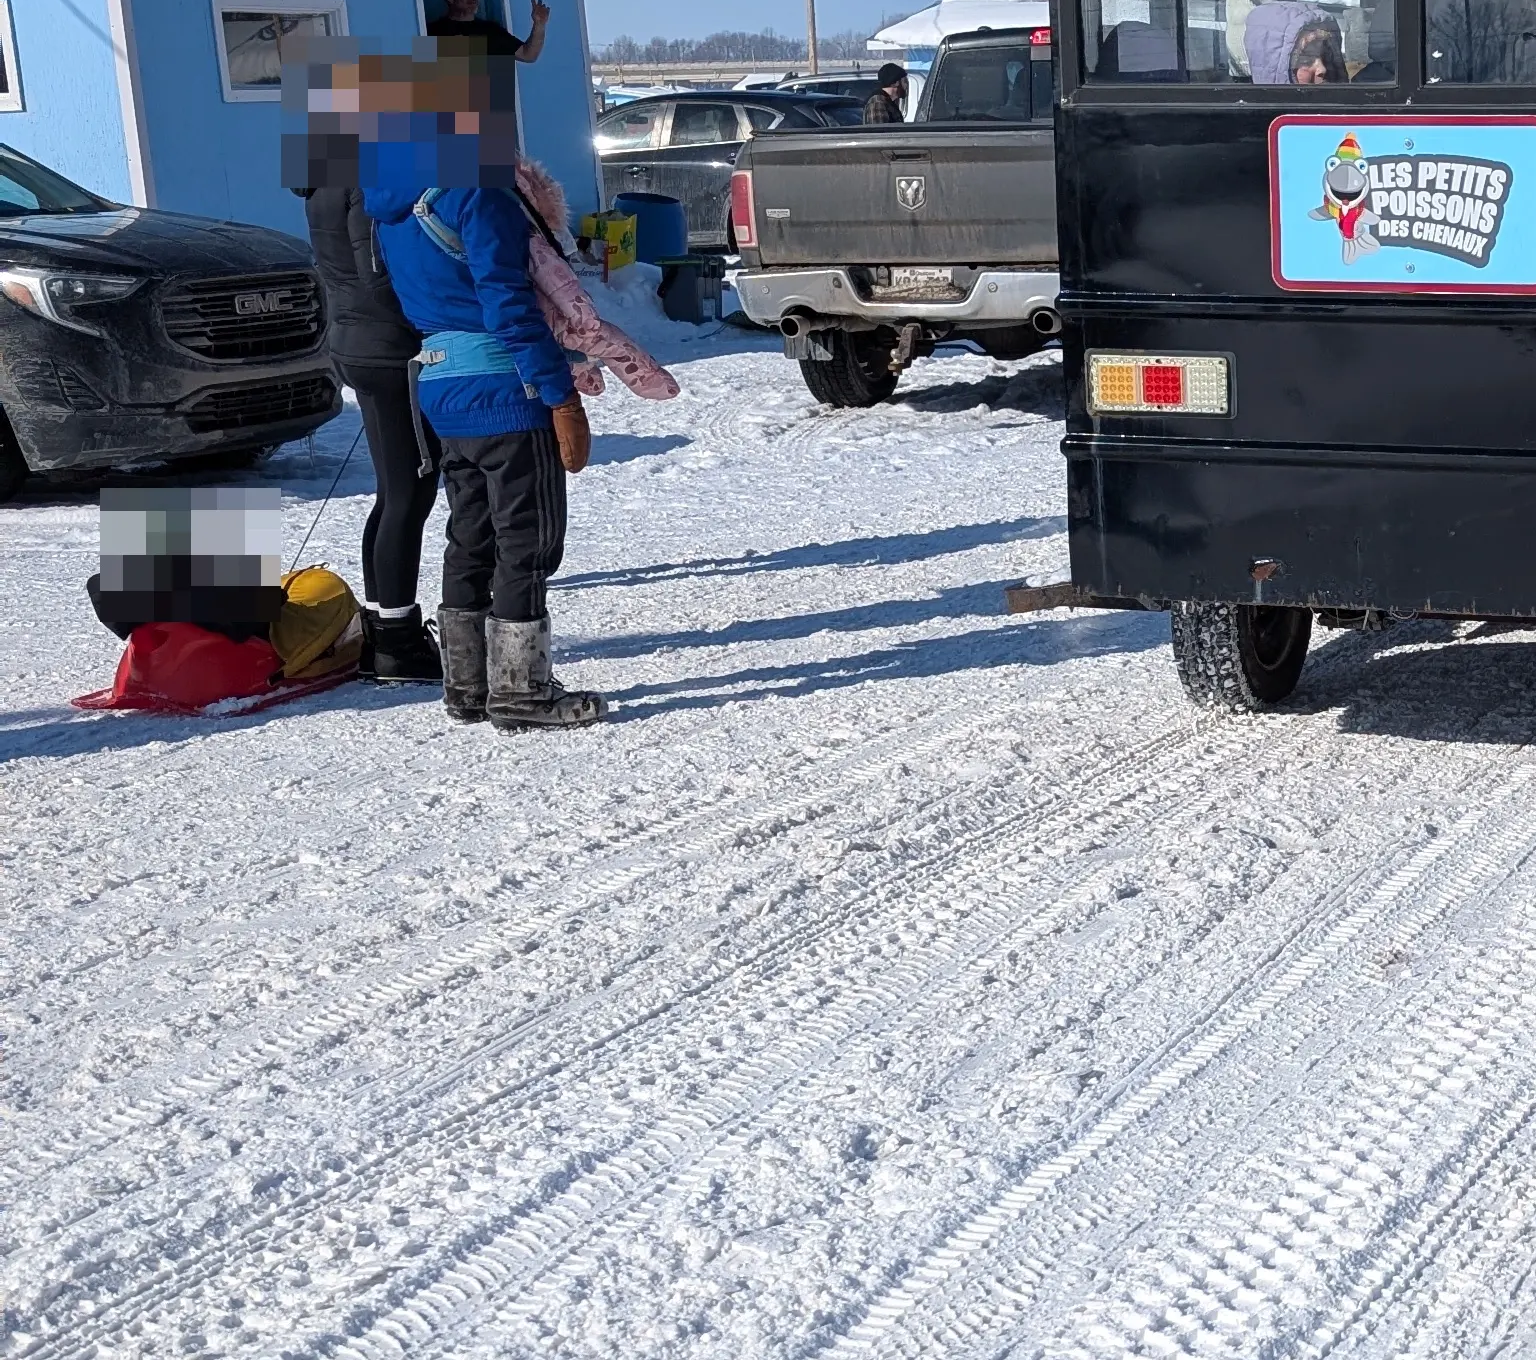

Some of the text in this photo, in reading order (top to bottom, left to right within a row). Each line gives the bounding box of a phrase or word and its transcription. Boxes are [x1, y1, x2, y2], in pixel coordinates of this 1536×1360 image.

[1369, 161, 1507, 201] LES PETITS
[1371, 190, 1498, 234] POISSONS
[1378, 219, 1489, 258] DES CHENAUX
[235, 291, 293, 314] GMC
